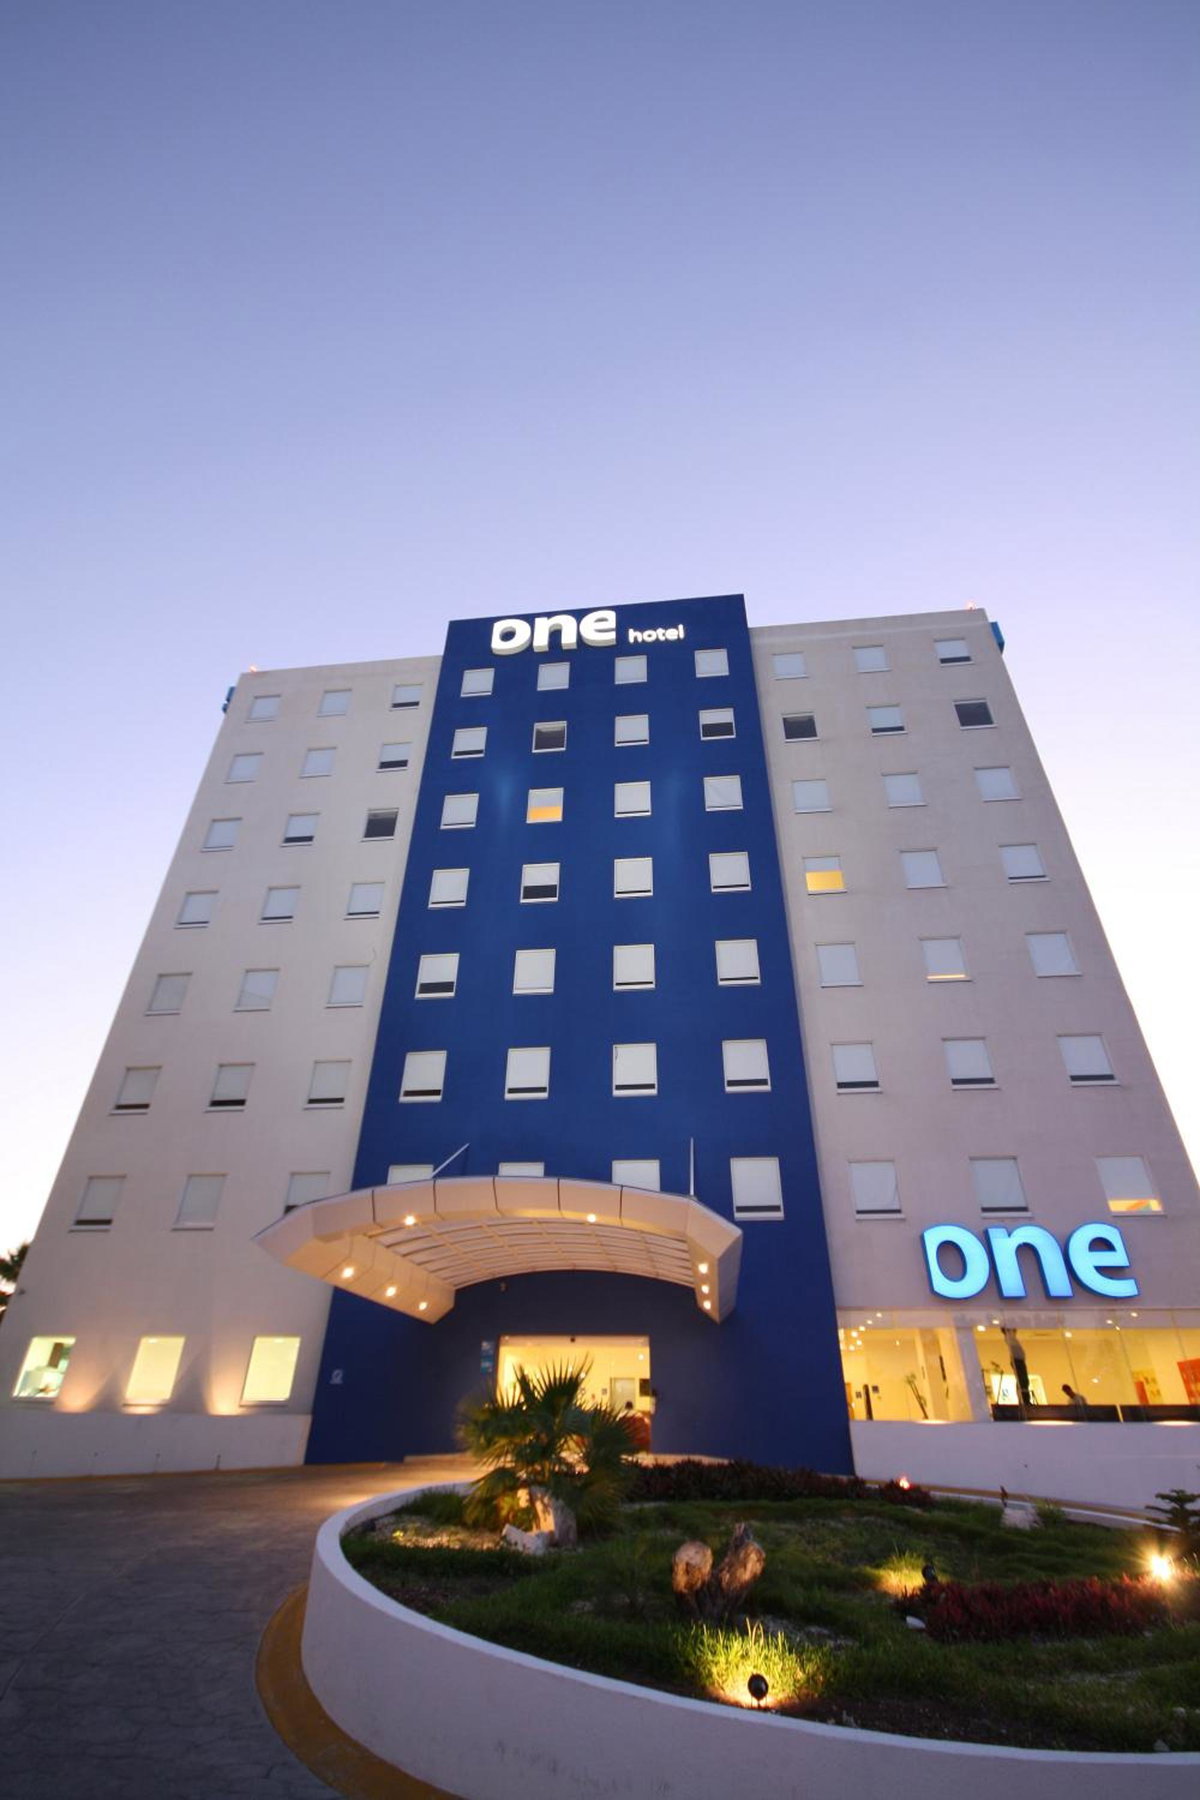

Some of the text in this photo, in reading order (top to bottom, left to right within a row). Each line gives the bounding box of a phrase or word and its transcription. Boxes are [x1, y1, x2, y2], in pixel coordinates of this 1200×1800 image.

[491, 610, 685, 656] one hotel
[921, 1222, 1140, 1299] one
